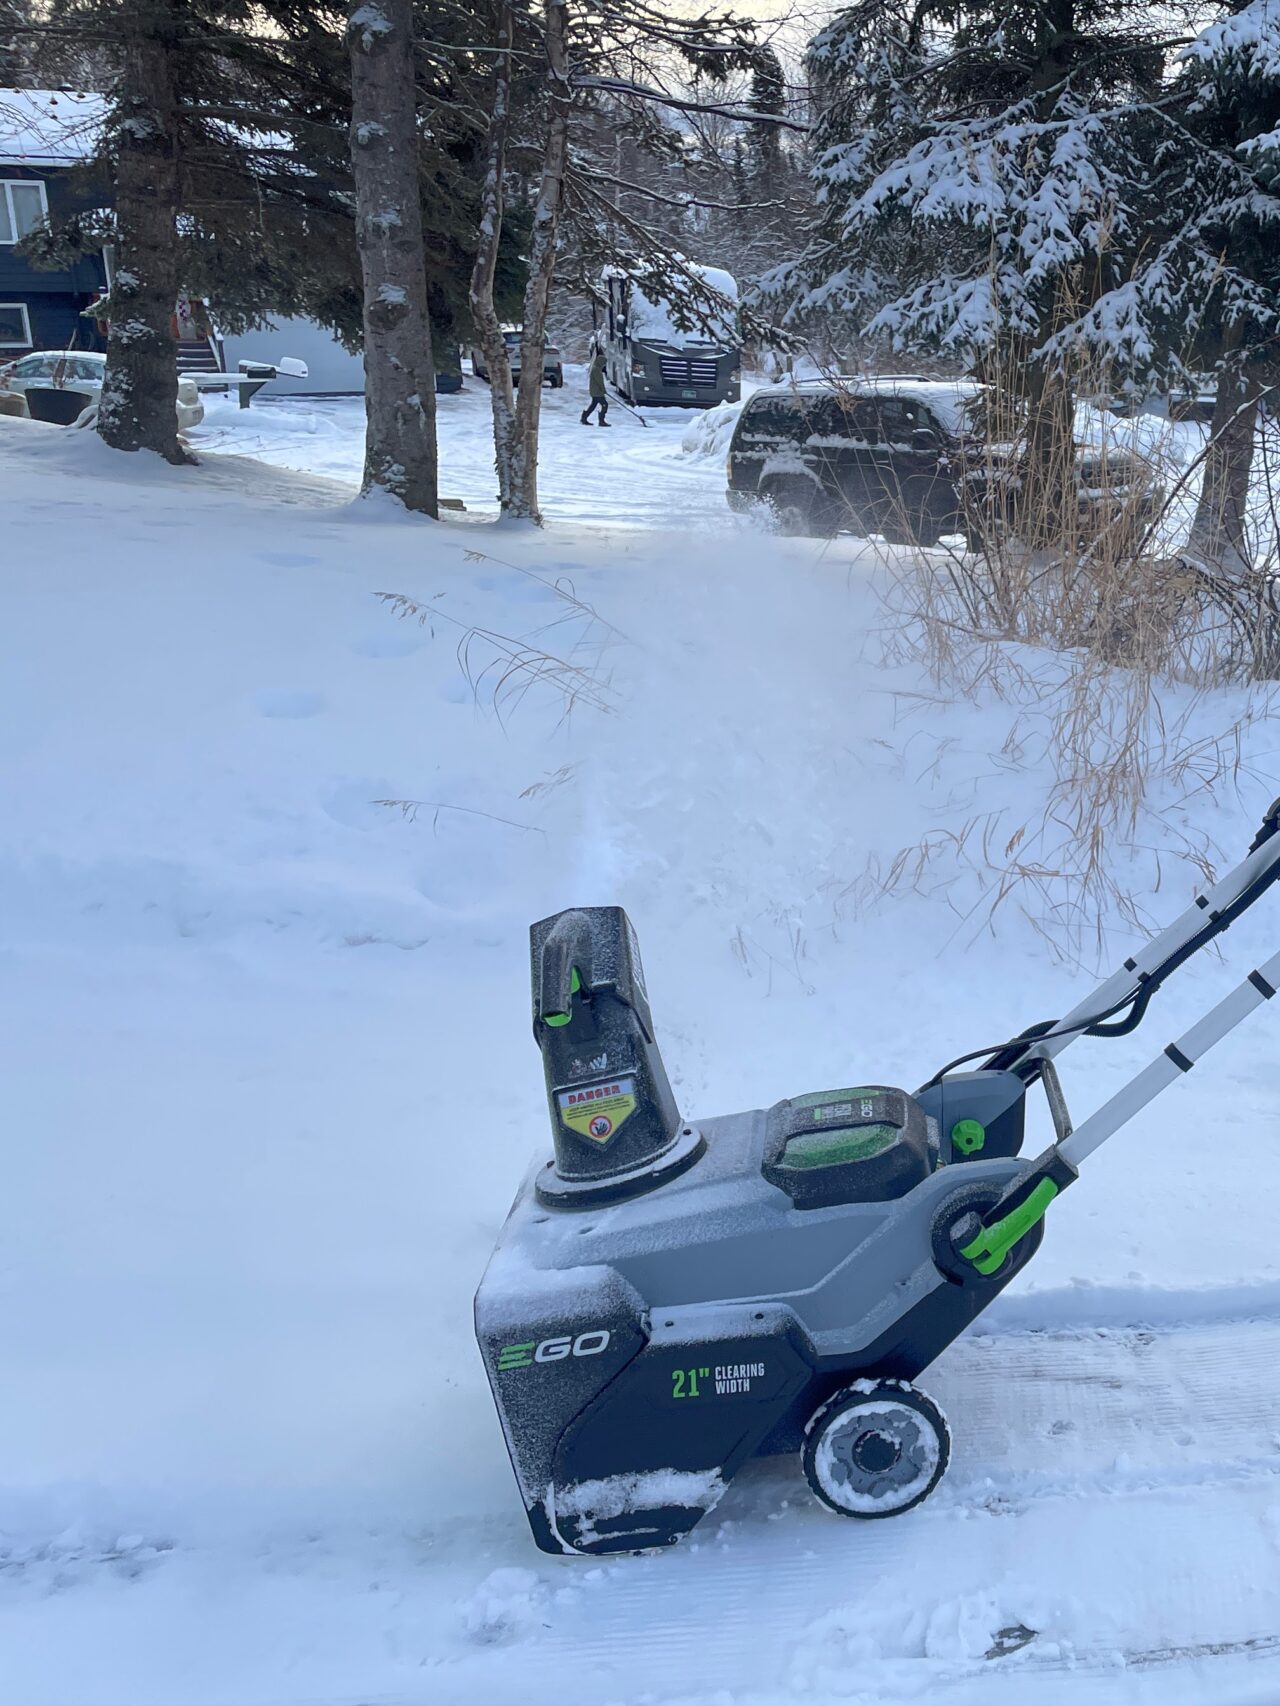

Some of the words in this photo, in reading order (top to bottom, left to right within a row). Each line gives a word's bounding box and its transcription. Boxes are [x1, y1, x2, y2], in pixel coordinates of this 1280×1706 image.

[568, 1085, 620, 1104] DANGER
[497, 1330, 610, 1371] EGO
[672, 1367, 710, 1398] 21"
[715, 1363, 765, 1380] CLEARING
[715, 1379, 750, 1395] WIDTH
